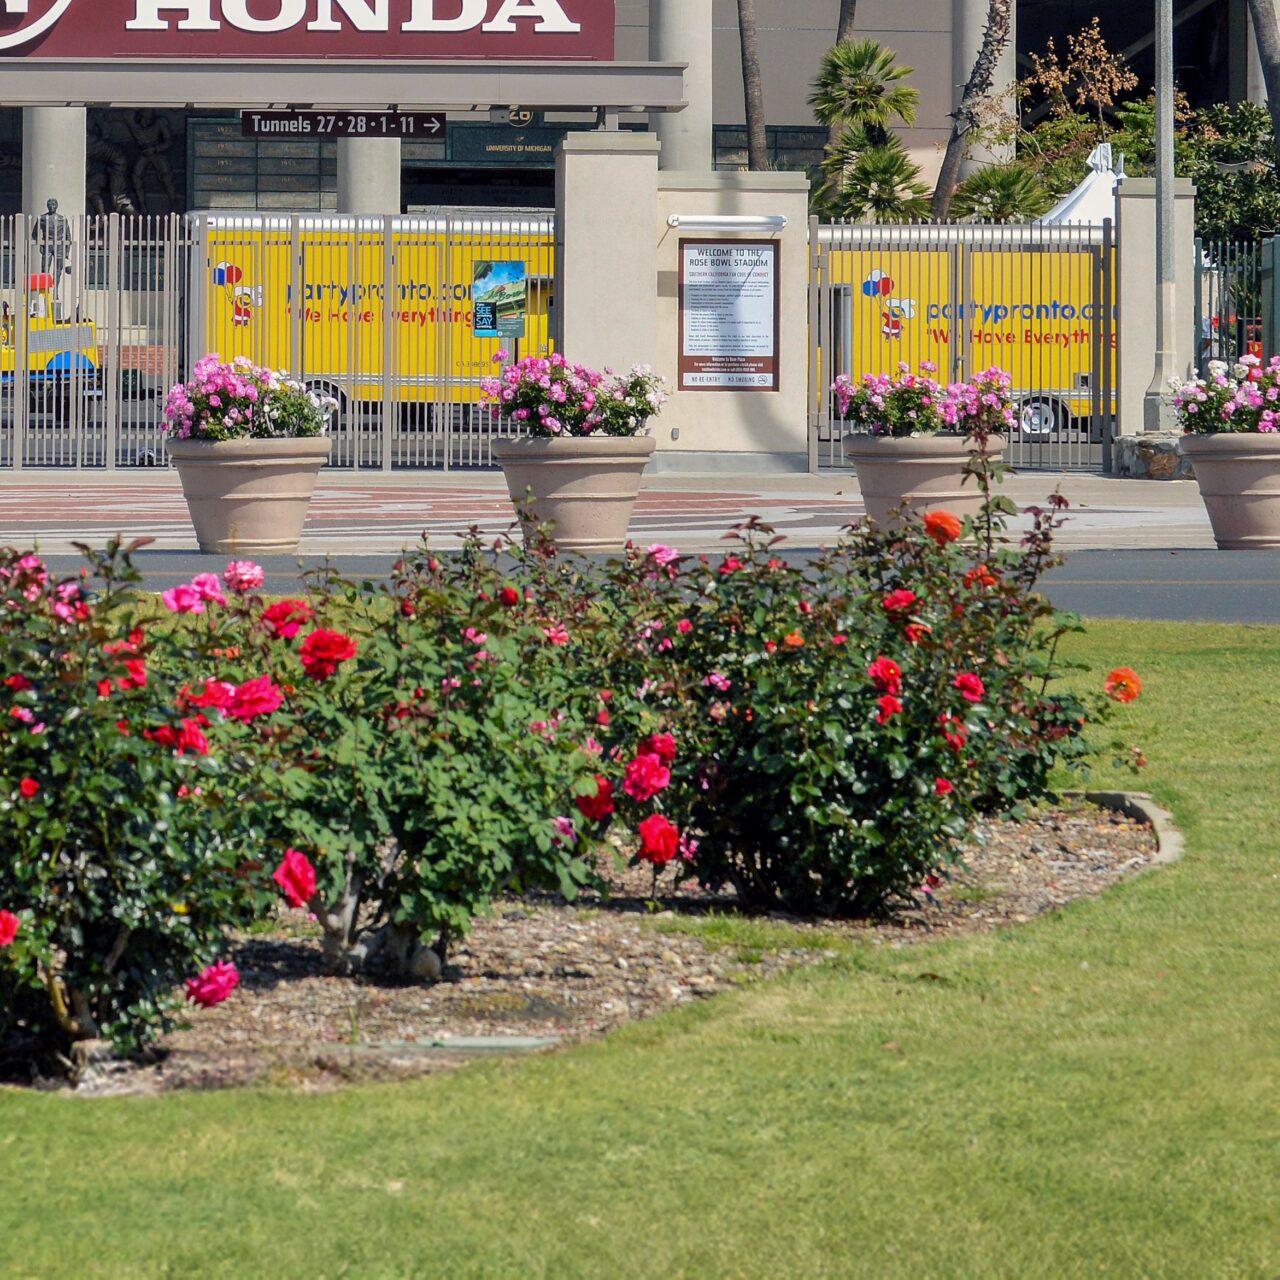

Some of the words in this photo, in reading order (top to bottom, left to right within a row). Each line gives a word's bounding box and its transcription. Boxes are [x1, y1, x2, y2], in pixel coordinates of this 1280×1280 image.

[252, 115, 311, 132] Tunnels
[317, 115, 336, 132] 27
[347, 116, 366, 133] 28
[380, 116, 387, 133] 1
[400, 116, 414, 133] 11
[689, 259, 710, 267] ROSE
[710, 259, 732, 267] BOWL
[734, 259, 768, 267] STADIUM
[287, 280, 475, 307] artypronto.co
[476, 306, 491, 314] SEE
[927, 300, 1117, 324] partypronto.c
[476, 317, 493, 325] SAY
